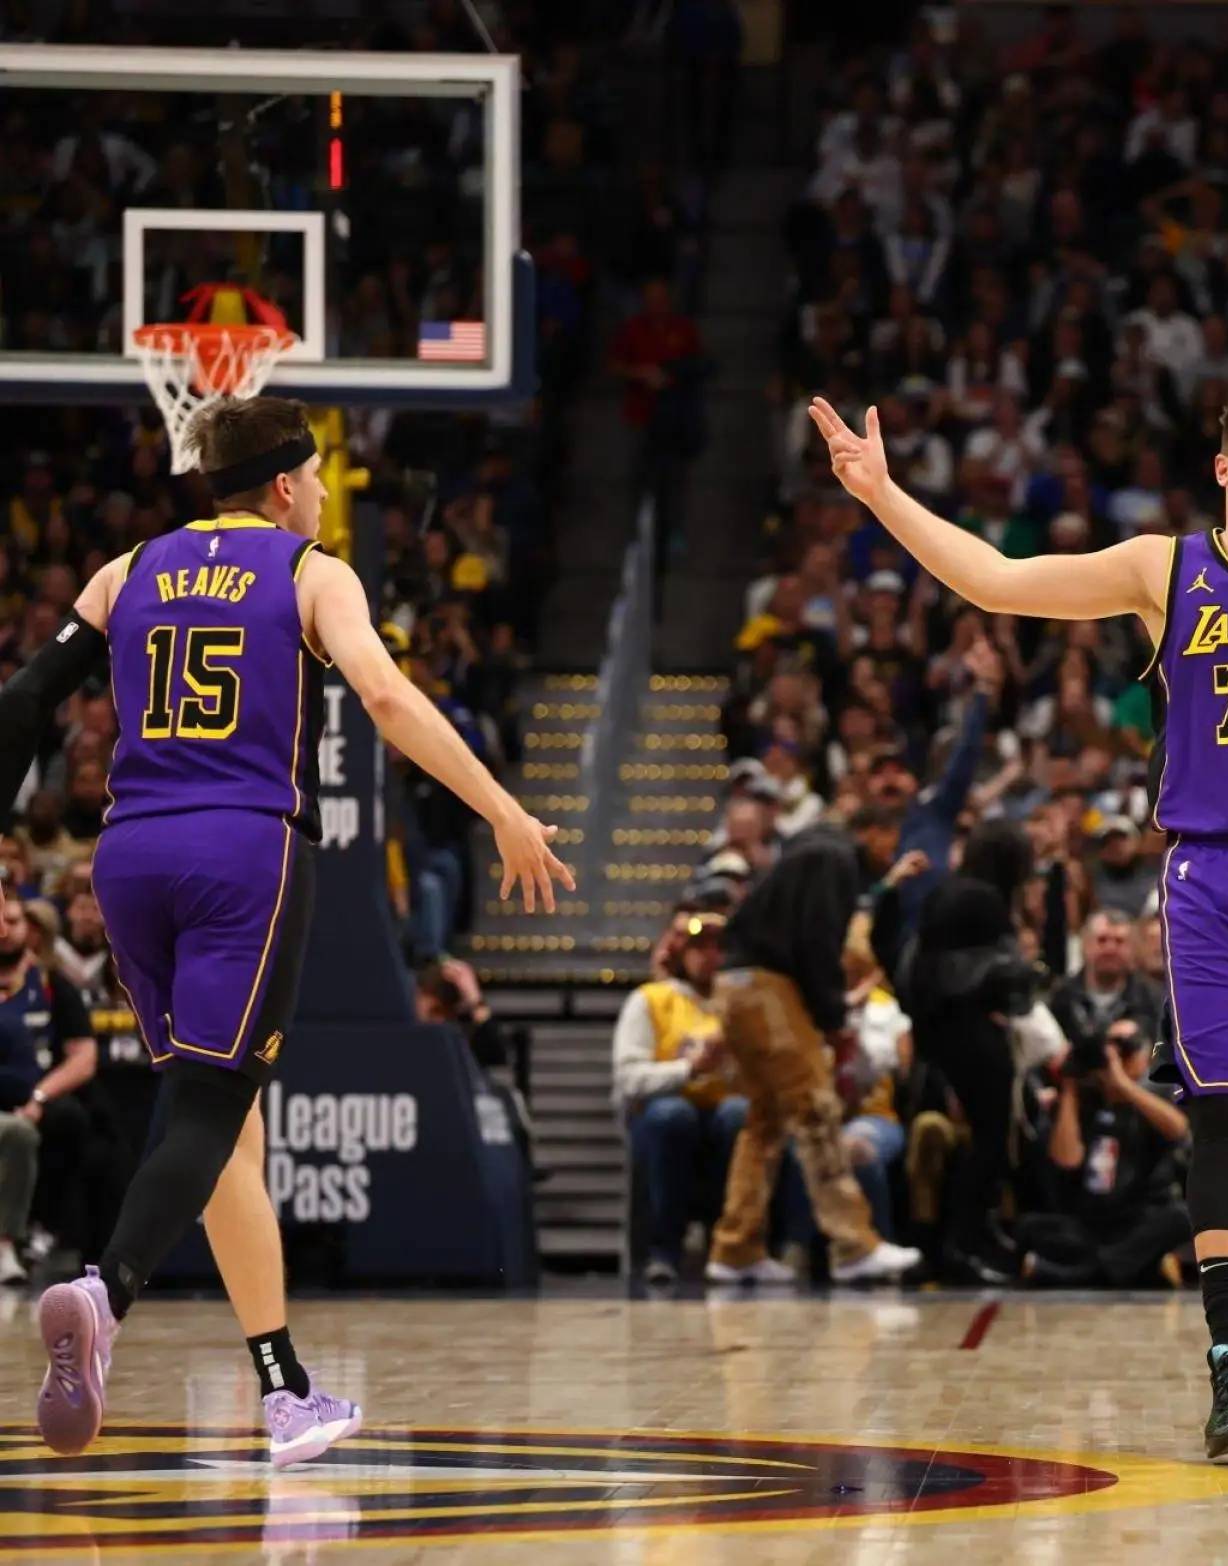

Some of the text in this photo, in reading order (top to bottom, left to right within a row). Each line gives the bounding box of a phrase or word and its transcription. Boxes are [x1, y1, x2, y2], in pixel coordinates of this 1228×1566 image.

[156, 564, 256, 603] REAVES
[141, 625, 245, 740] 15
[267, 1079, 418, 1164] League
[267, 1151, 371, 1223] Pass
